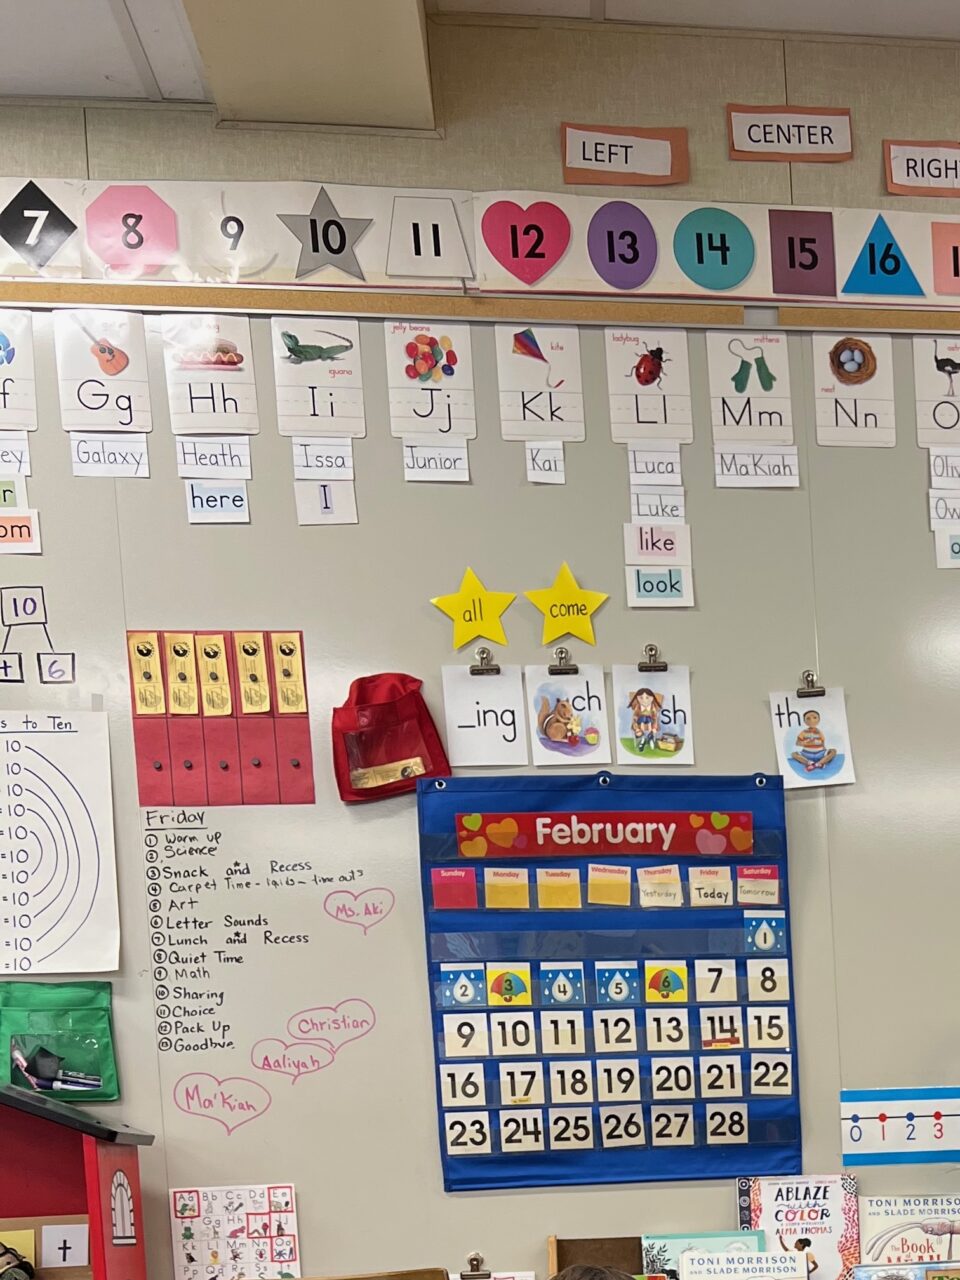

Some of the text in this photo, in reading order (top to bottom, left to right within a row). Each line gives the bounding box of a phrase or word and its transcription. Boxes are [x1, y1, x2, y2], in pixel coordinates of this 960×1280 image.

[747, 122, 834, 146] CENTER
[581, 140, 634, 166] LEFT
[23, 209, 50, 246] 7
[309, 218, 347, 255] 10
[509, 223, 547, 261] 12
[867, 241, 901, 277] 16
[76, 440, 144, 475] Galaxy
[182, 441, 243, 468] Heath
[300, 444, 347, 470] Issa
[405, 445, 463, 471] Junior
[531, 447, 561, 471] Kai
[633, 450, 675, 474] Luca
[191, 483, 244, 509] here
[636, 493, 679, 517] Luke
[639, 526, 675, 551] like
[636, 569, 681, 593] look
[463, 598, 483, 623] all
[550, 602, 588, 618] come
[572, 681, 602, 712] ch
[775, 697, 800, 729] th
[146, 810, 206, 826] Friday
[206, 832, 222, 844] up
[536, 814, 677, 850] February
[164, 845, 218, 860] Science
[163, 865, 209, 880] Snack
[270, 861, 313, 874] Recess
[440, 869, 466, 879] Sunday
[492, 871, 520, 880] Monday
[591, 866, 629, 876] Wednesday
[743, 867, 772, 877] Saturday
[169, 877, 251, 895] Carpet Time
[641, 888, 677, 903] Yesterday
[695, 886, 729, 903] Today
[739, 885, 776, 898] Tomorrow
[168, 899, 199, 912] Art
[166, 915, 269, 930] Letter Sounds
[168, 935, 208, 947] Lunch
[264, 931, 309, 945] Recess
[168, 950, 244, 965] Quiet Time
[175, 969, 210, 980] Math
[173, 987, 224, 1006] Sharing
[173, 1005, 216, 1017] Choice
[175, 1021, 230, 1040] Pack Up
[298, 1015, 371, 1034] Christian
[553, 968, 723, 1142] 7 12 25
[262, 1055, 320, 1075] Aaliyah
[690, 1255, 797, 1266] TONI MORRISON
[742, 1265, 797, 1274] MORRISON
